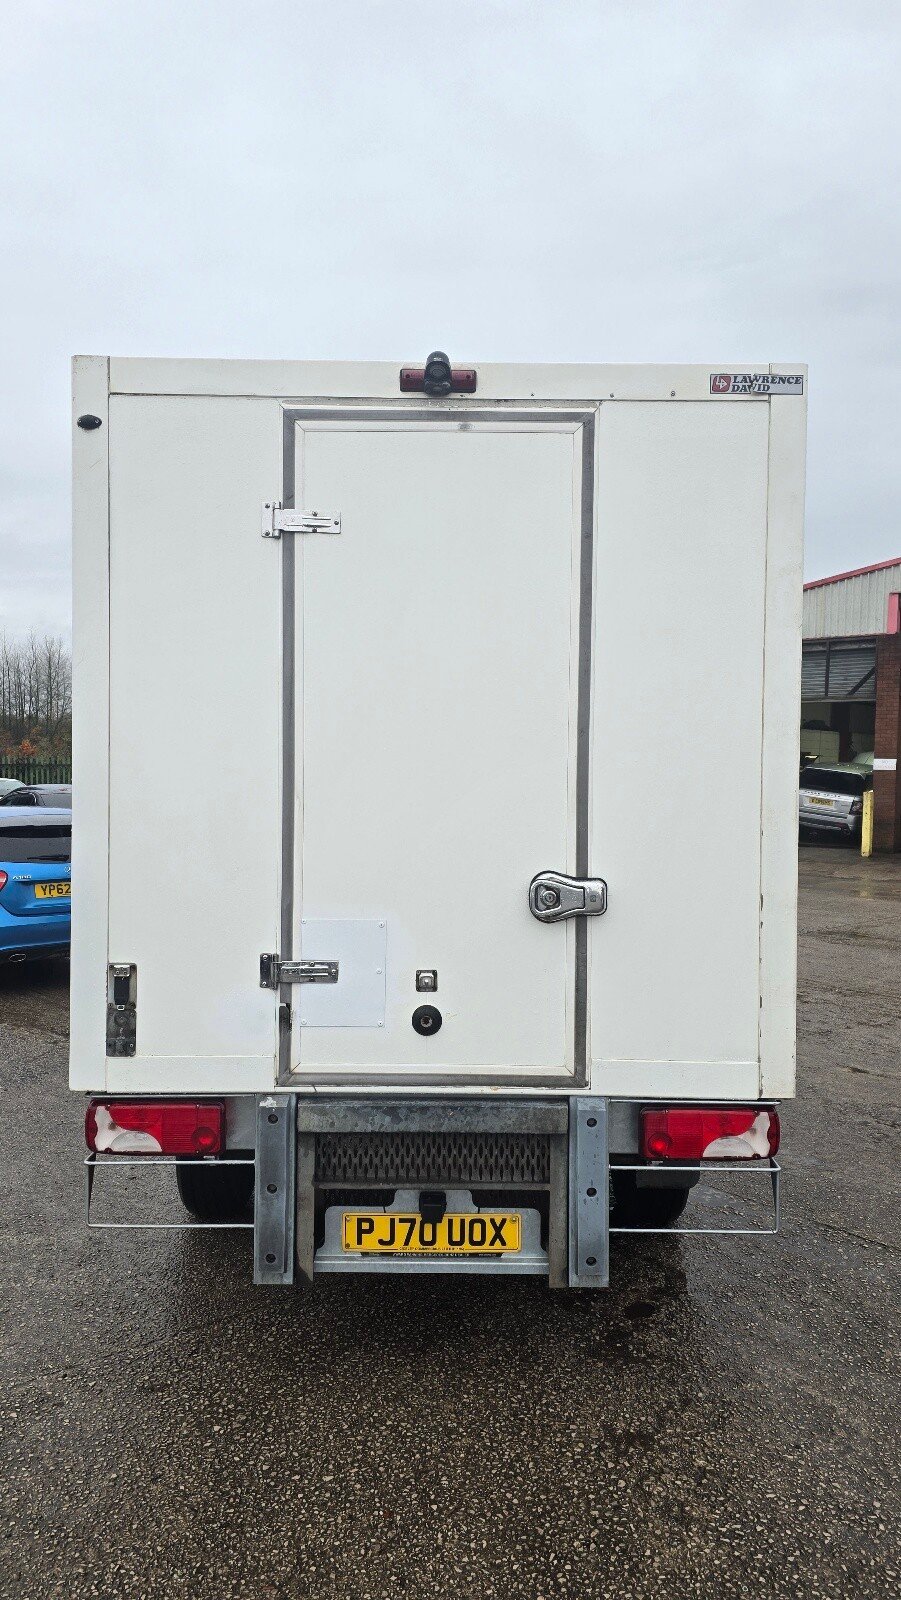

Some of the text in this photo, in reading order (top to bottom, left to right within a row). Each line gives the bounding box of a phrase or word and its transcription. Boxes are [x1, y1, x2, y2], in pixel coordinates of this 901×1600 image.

[733, 376, 803, 385] LAWRENCE
[731, 384, 771, 392] DAVID
[41, 884, 71, 896] YP62
[356, 1217, 507, 1247] PJ70 UOX
